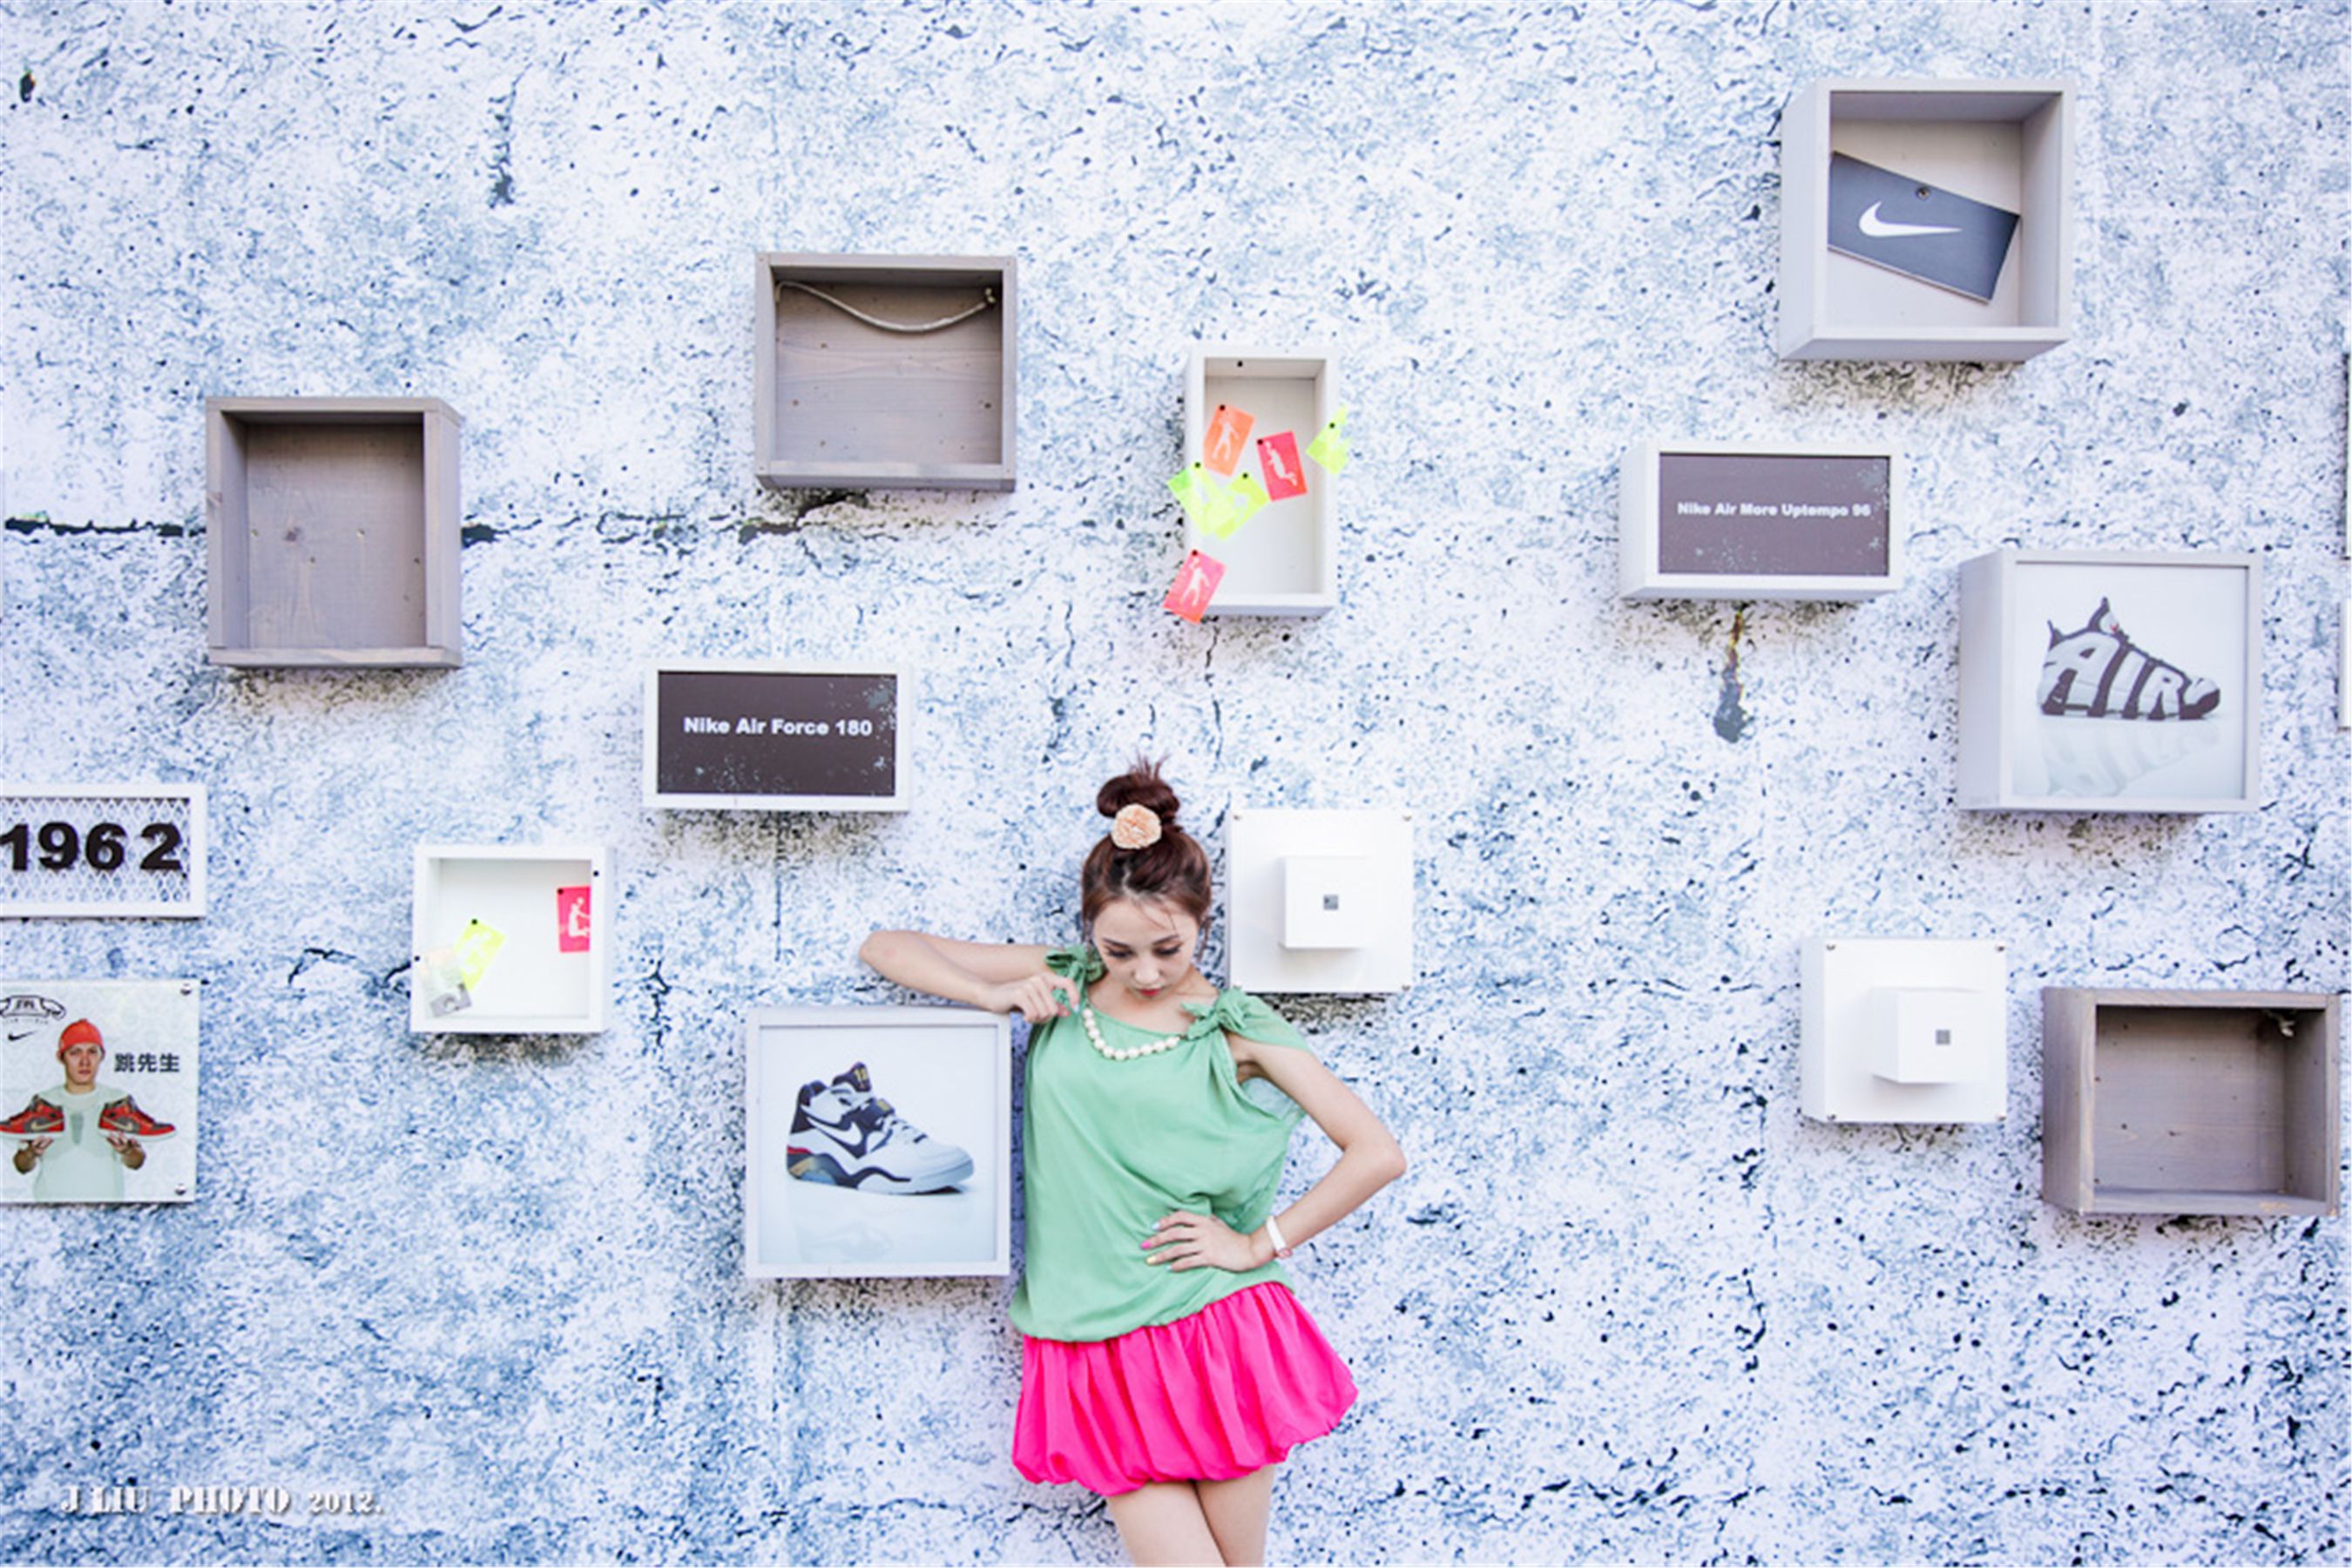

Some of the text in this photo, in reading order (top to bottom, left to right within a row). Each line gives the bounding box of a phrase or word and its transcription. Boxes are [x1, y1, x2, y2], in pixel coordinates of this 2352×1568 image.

[1676, 502, 1711, 516] Nike
[1714, 503, 1736, 516] Air
[1740, 504, 1778, 517] More
[1781, 504, 1848, 518] Uptempo
[684, 717, 873, 736] Nike Air Force 180
[0, 821, 183, 872] 1962
[114, 1052, 180, 1072] 跳先生
